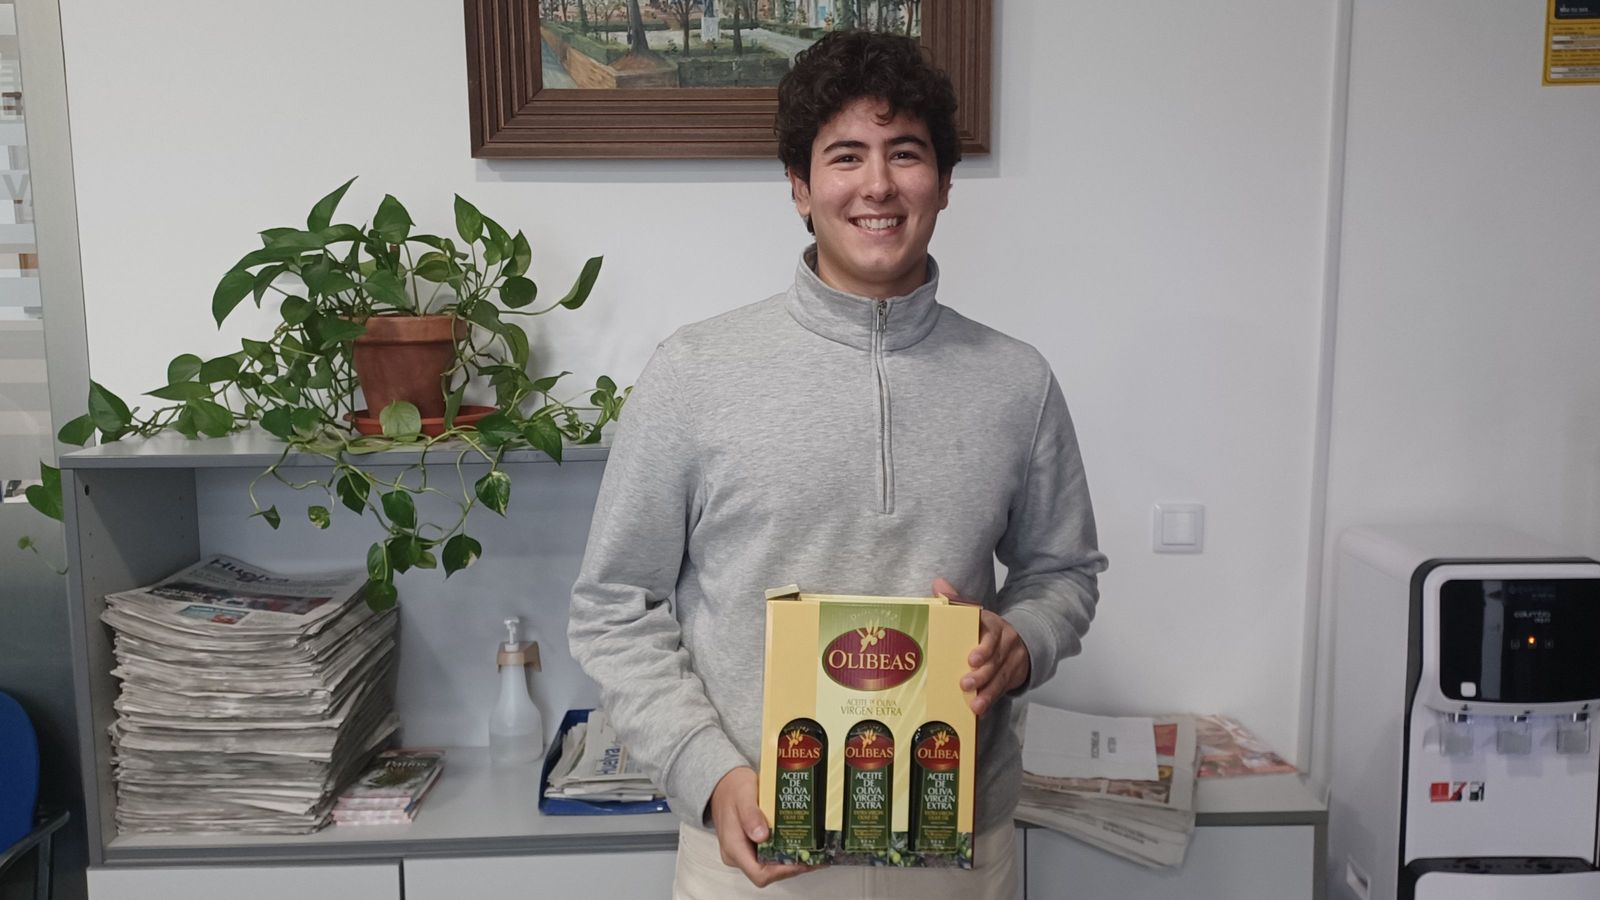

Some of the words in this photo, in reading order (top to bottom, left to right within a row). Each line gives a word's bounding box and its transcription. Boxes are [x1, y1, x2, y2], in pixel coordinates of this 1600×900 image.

[828, 649, 916, 671] OLIBEAS
[840, 705, 874, 715] VIRGEN
[875, 706, 903, 716] EXTRA
[846, 747, 894, 759] OLIBEAS
[917, 748, 959, 760] OLIBEA
[781, 772, 809, 780] ACEITE
[855, 772, 882, 780] ACEITE
[927, 773, 955, 781] ACEITE
[935, 780, 946, 788] DE
[782, 787, 808, 795] OLIVA
[856, 787, 881, 795] OLIVA
[779, 794, 811, 802] VIRGEN
[853, 794, 885, 802] VIRGEN
[924, 795, 955, 803] VIRGEN
[927, 802, 952, 810] EXTRA
